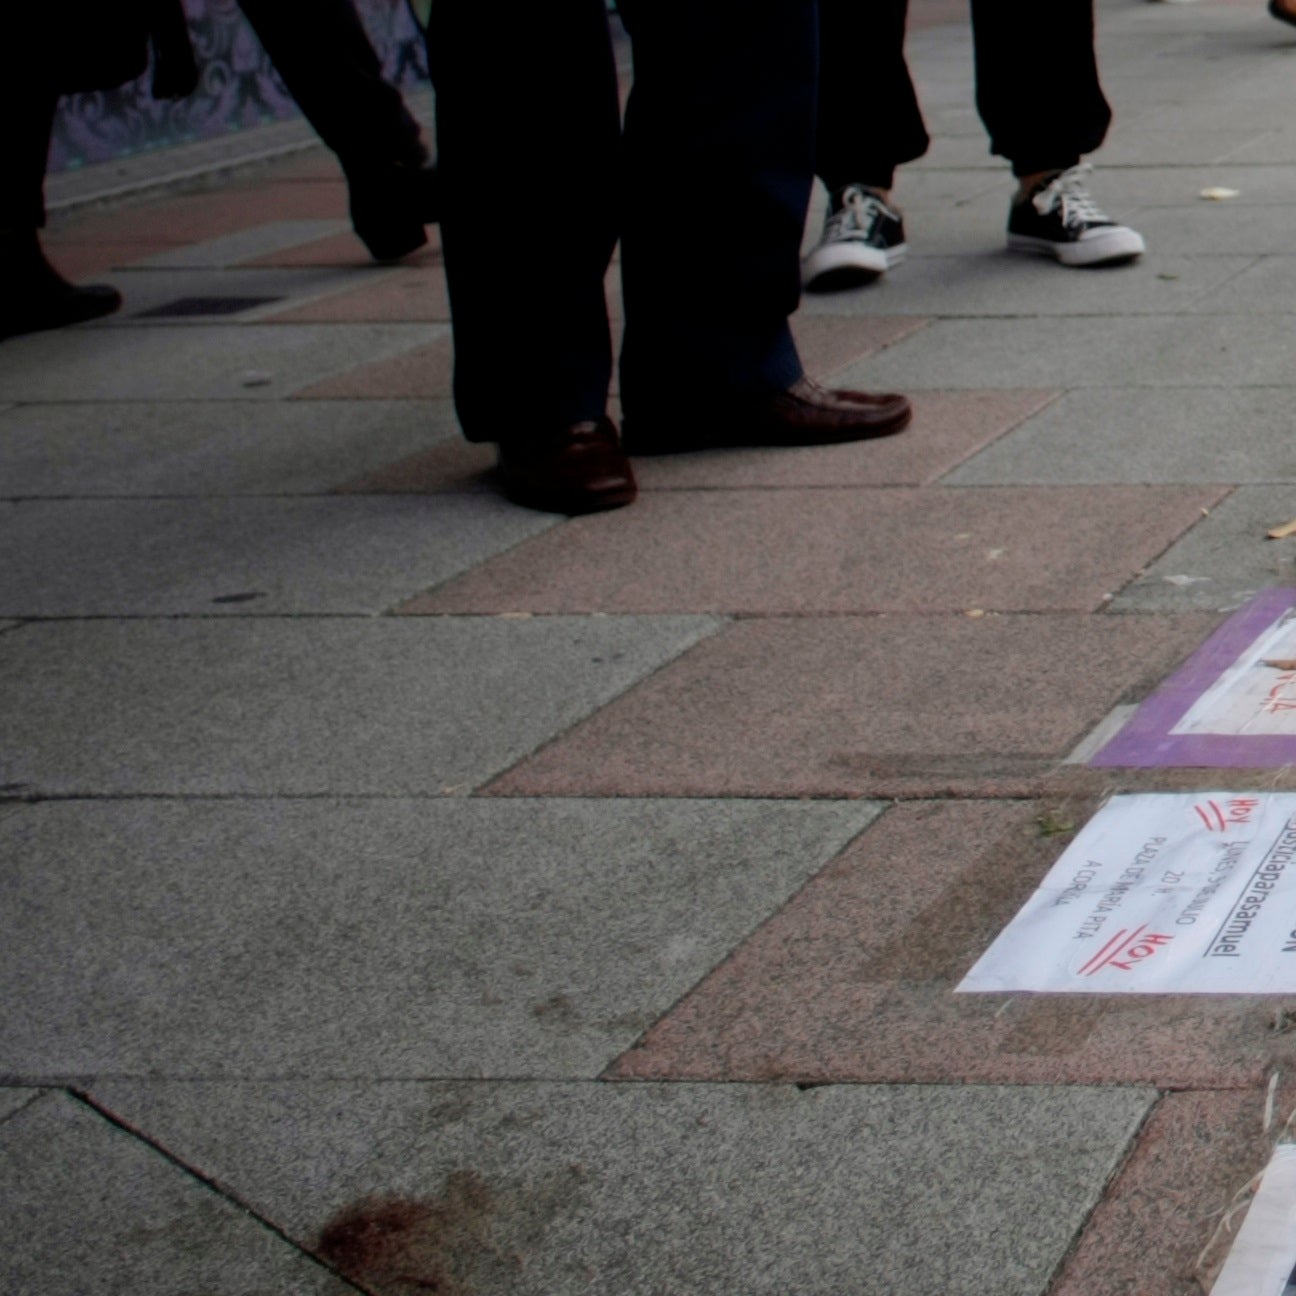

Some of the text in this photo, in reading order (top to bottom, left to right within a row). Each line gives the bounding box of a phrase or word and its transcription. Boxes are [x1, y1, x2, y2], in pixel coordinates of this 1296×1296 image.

[1227, 798, 1260, 824] HOY
[1132, 836, 1169, 867] PLAZA
[1160, 870, 1186, 885] 20
[1092, 880, 1134, 914] MARÍA
[1072, 914, 1108, 941] PITA
[1109, 933, 1175, 970] HOY
